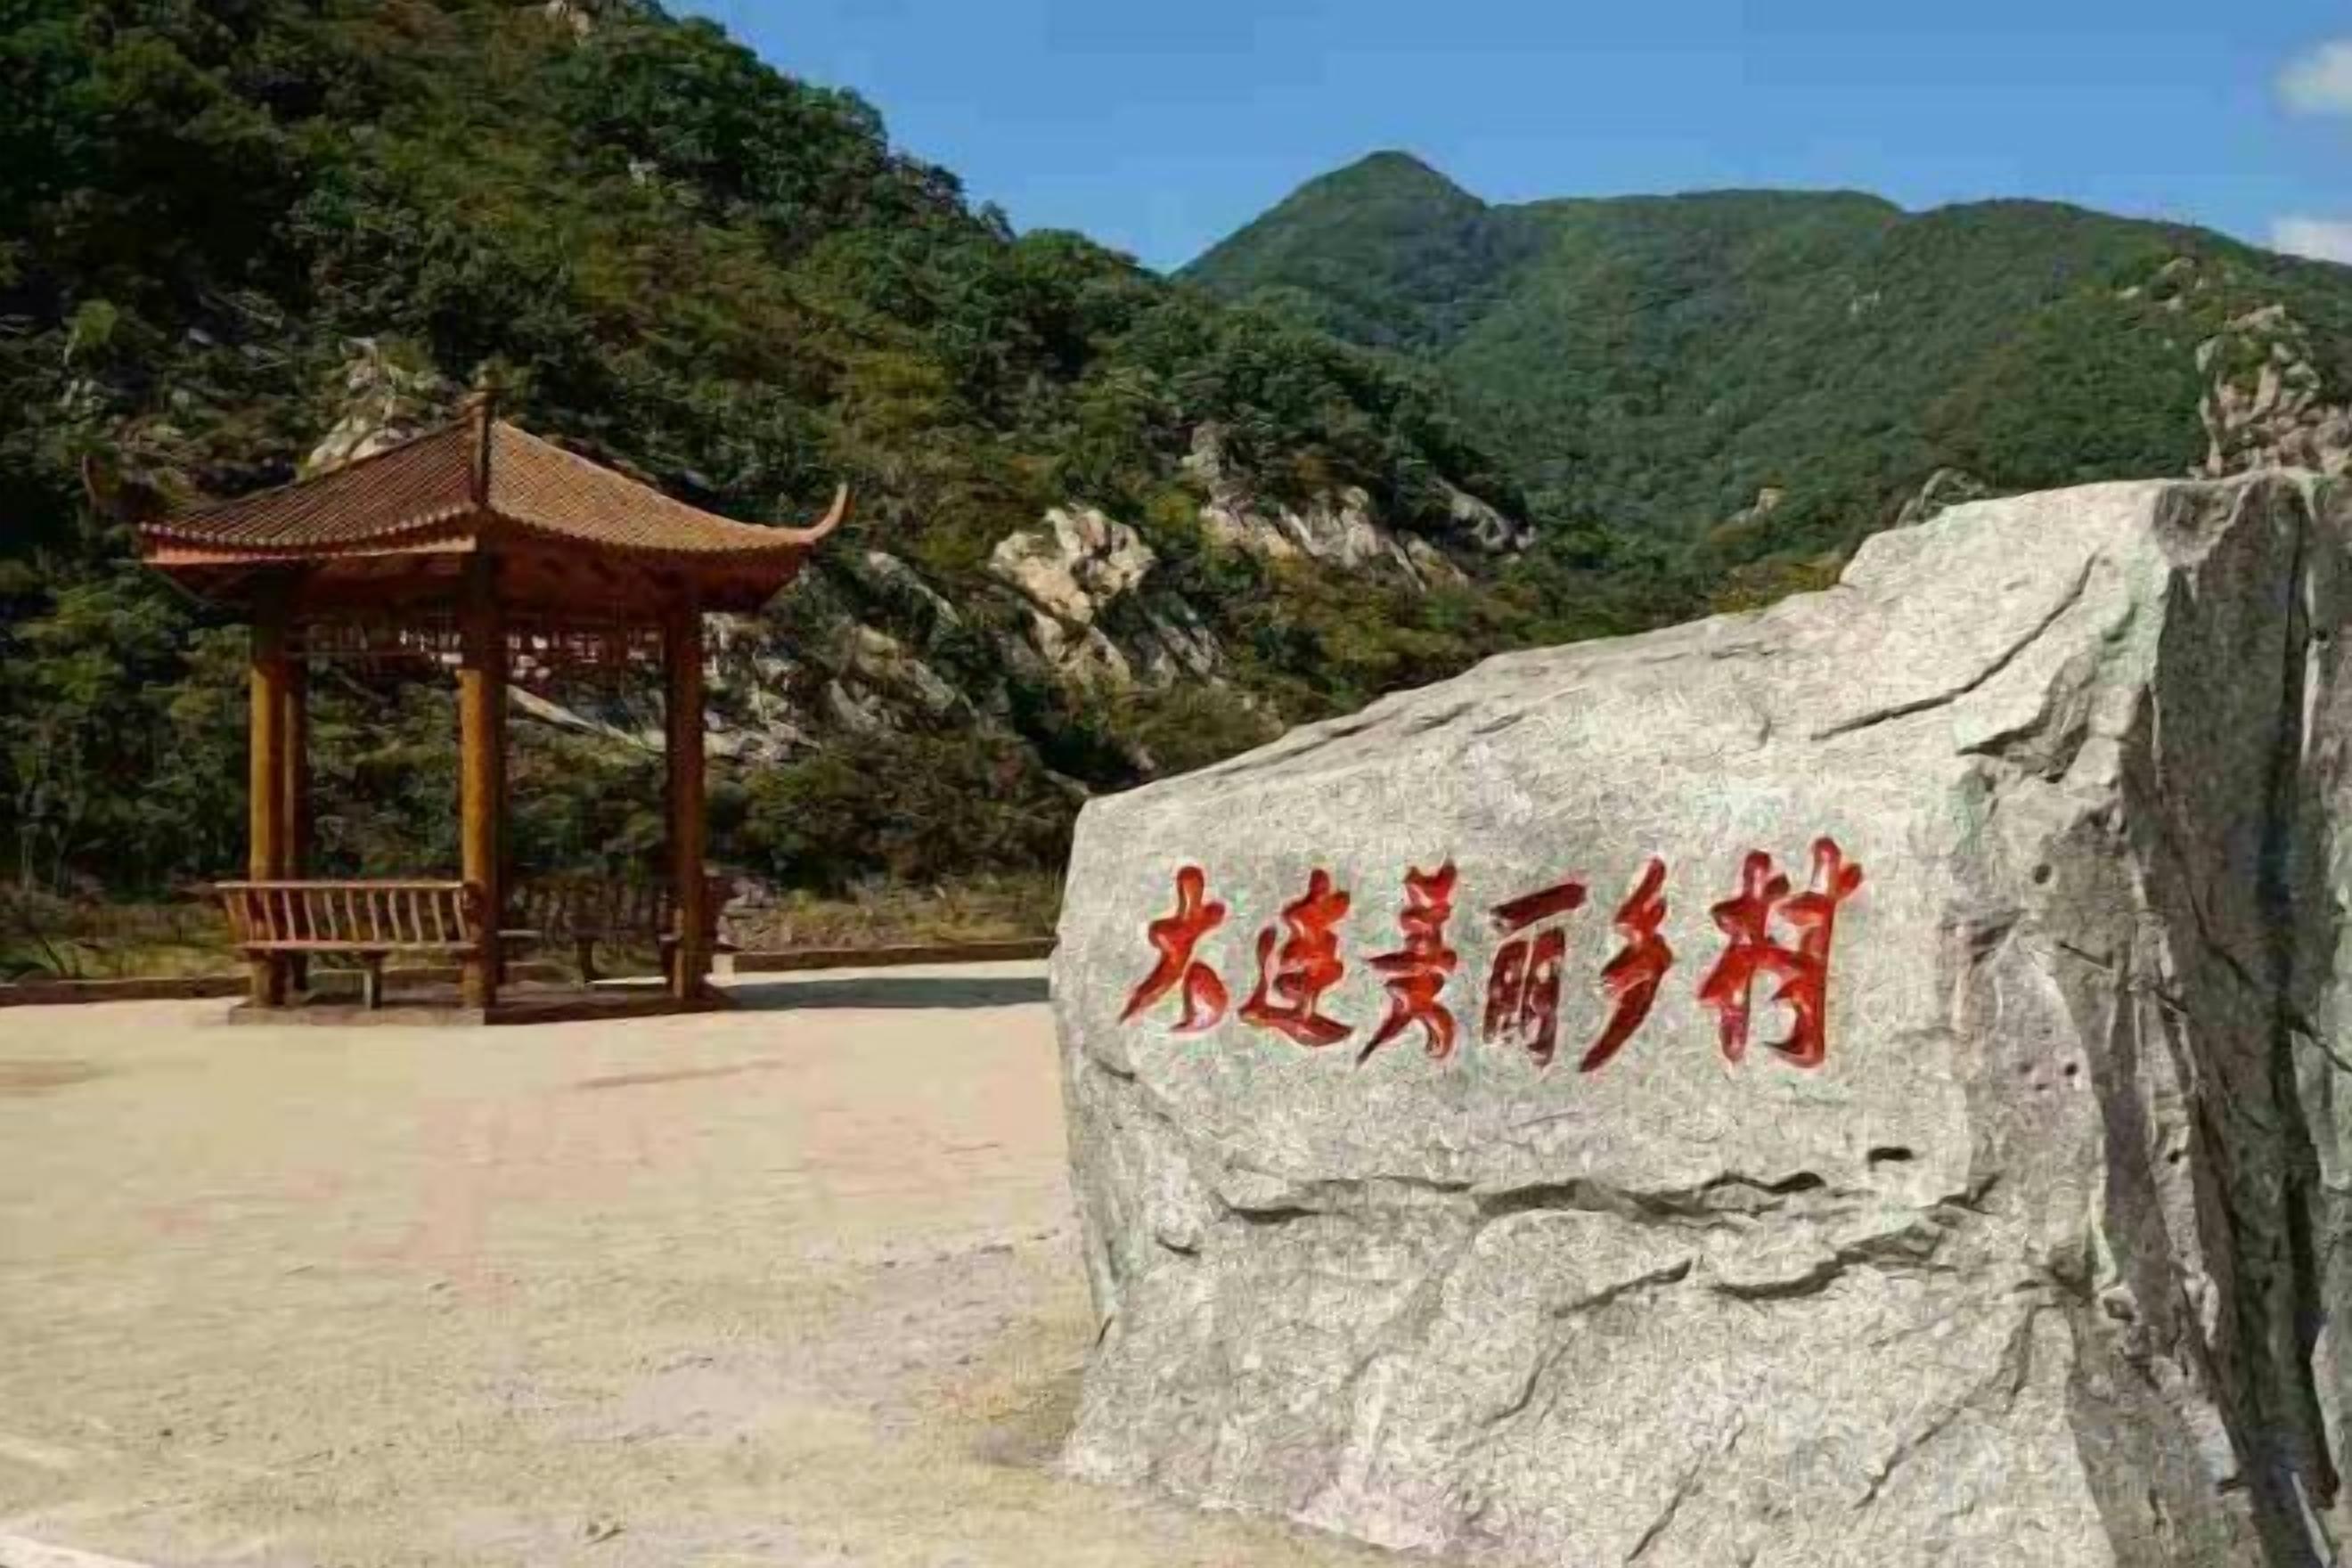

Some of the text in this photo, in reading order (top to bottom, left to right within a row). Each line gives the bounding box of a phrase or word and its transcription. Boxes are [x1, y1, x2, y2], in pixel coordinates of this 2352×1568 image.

[1120, 837, 1862, 1072] 大连美丽乡村
